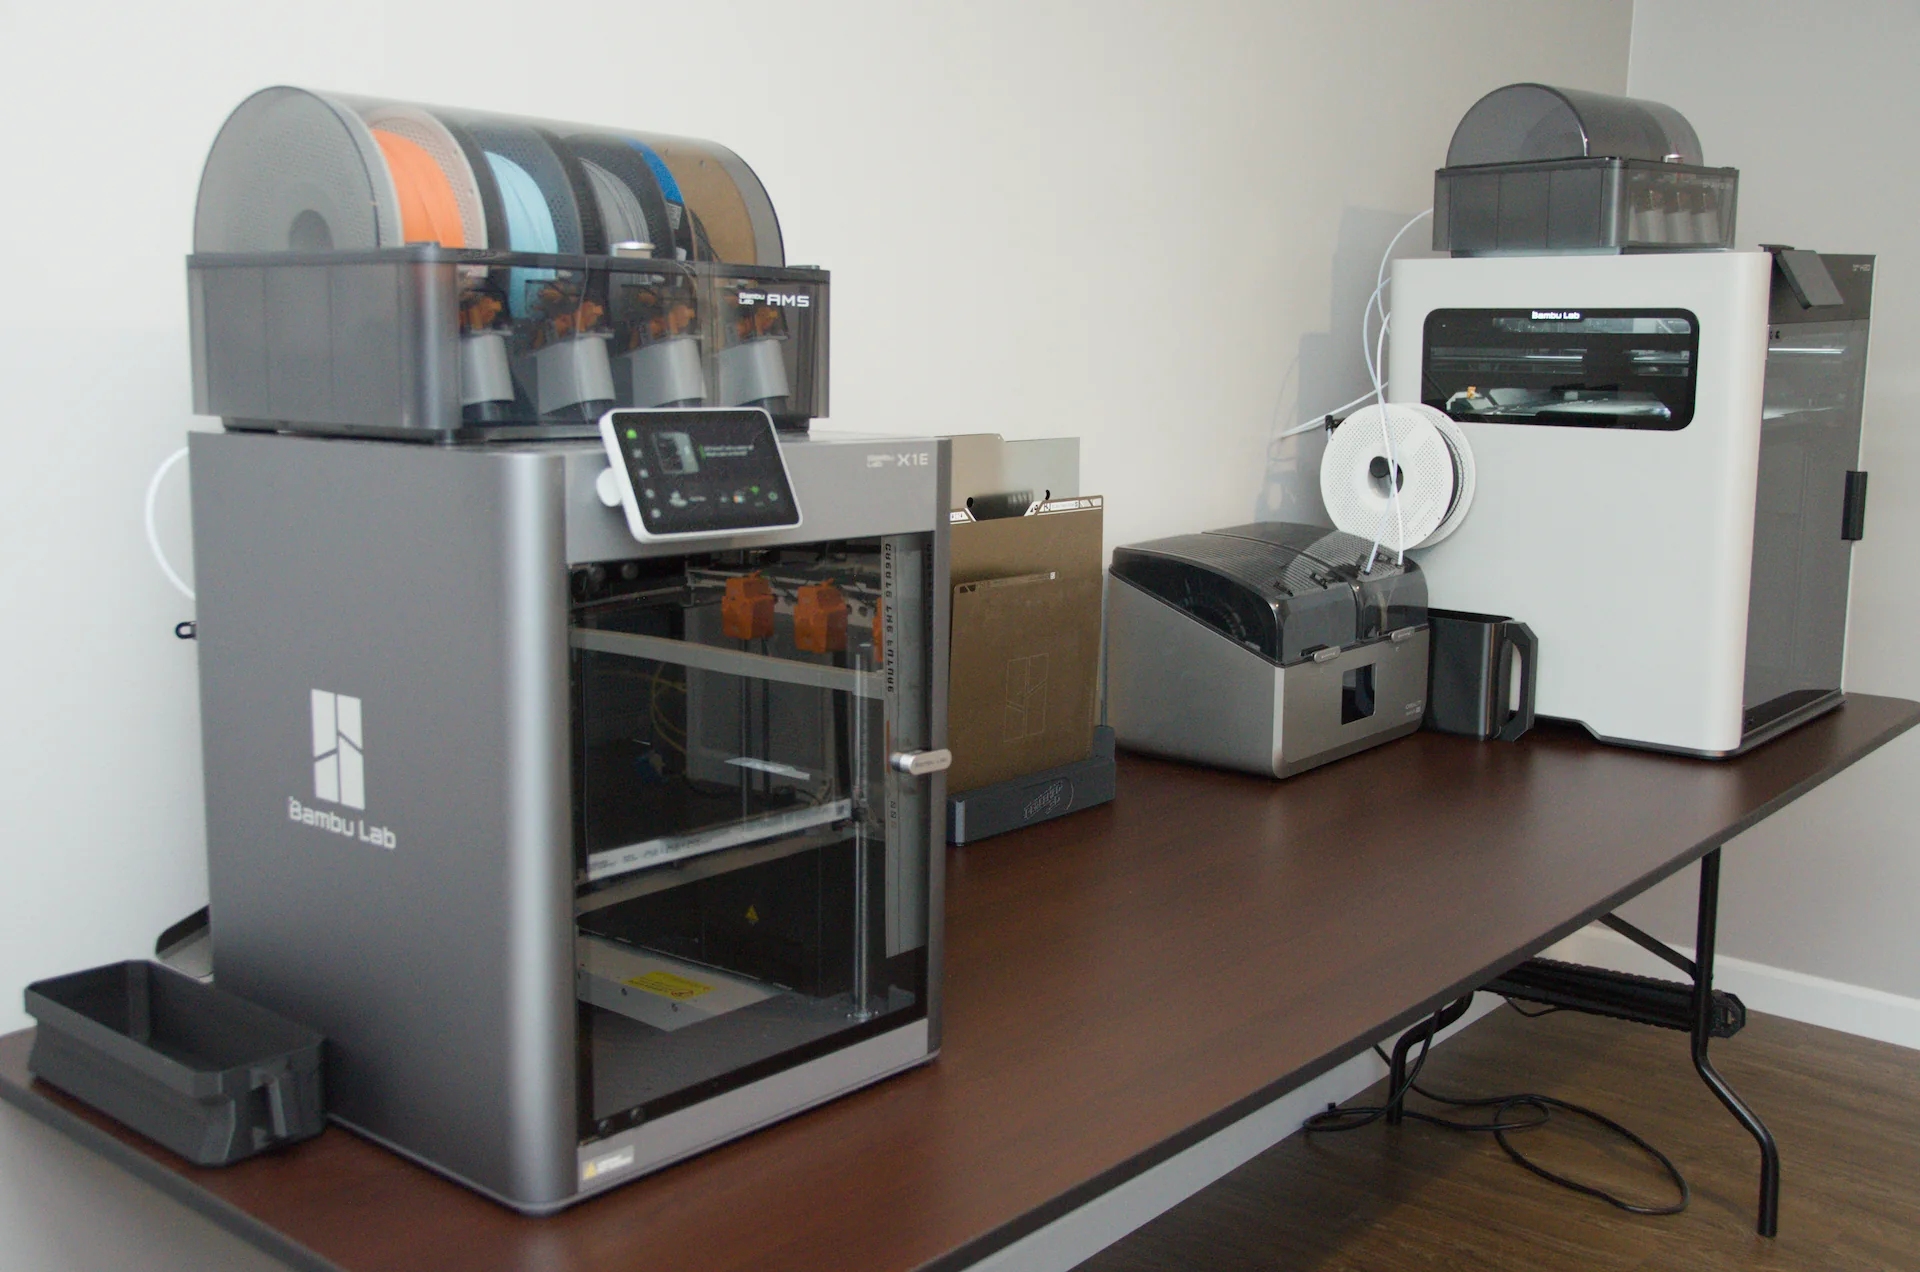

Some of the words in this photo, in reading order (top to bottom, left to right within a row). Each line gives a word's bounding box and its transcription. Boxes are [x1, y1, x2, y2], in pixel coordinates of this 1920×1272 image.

[766, 294, 809, 307] AMS
[1531, 310, 1562, 319] Bambu
[897, 453, 928, 467] X1E
[288, 796, 354, 837] Bambu
[359, 819, 396, 850] Lab
